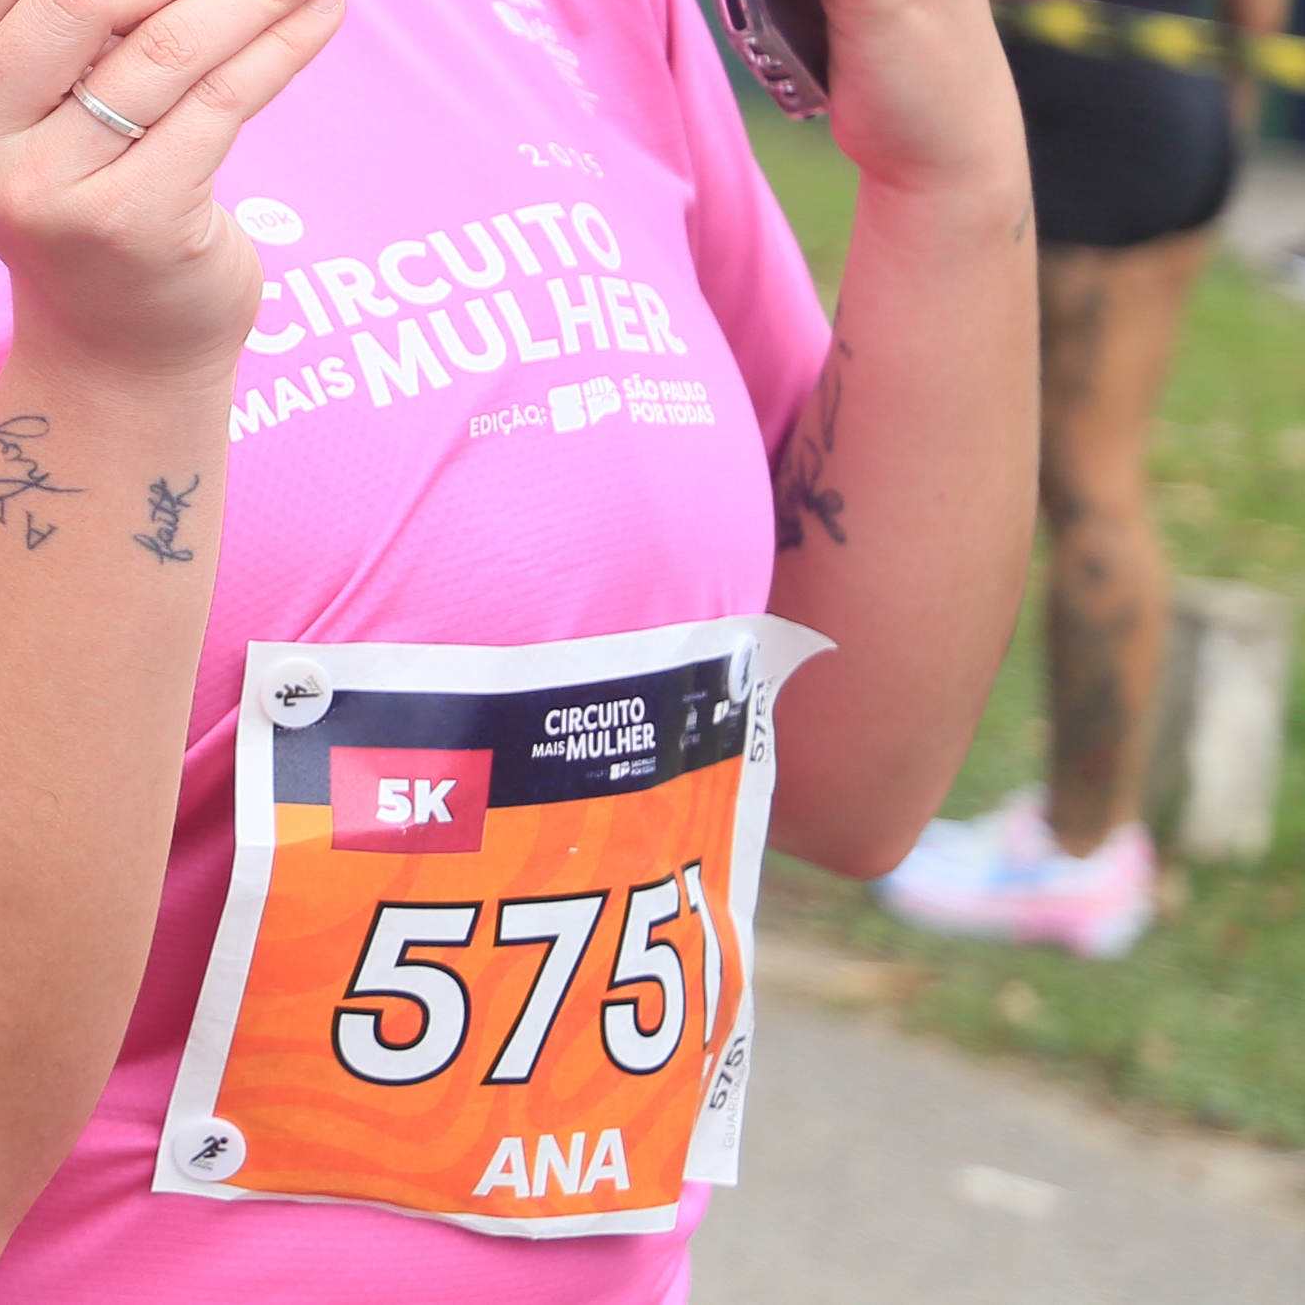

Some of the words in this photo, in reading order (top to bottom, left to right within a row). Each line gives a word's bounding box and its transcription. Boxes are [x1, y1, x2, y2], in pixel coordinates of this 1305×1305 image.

[246, 209, 290, 232] 10k
[243, 200, 623, 355] CIRCUITO
[228, 354, 356, 444] MAIS
[350, 274, 689, 409] MULHER
[621, 372, 660, 401] SÃO
[660, 380, 709, 403] PAULO
[469, 403, 548, 438] EDIÇÃO:
[629, 400, 667, 425] POR
[665, 402, 717, 427] TODAS
[543, 696, 647, 736] CIRCUITO
[531, 740, 566, 759] MAIS
[565, 722, 657, 762] MULHER
[375, 777, 459, 825] 5K
[330, 856, 723, 1087] 5751
[470, 1127, 631, 1198] ANA
